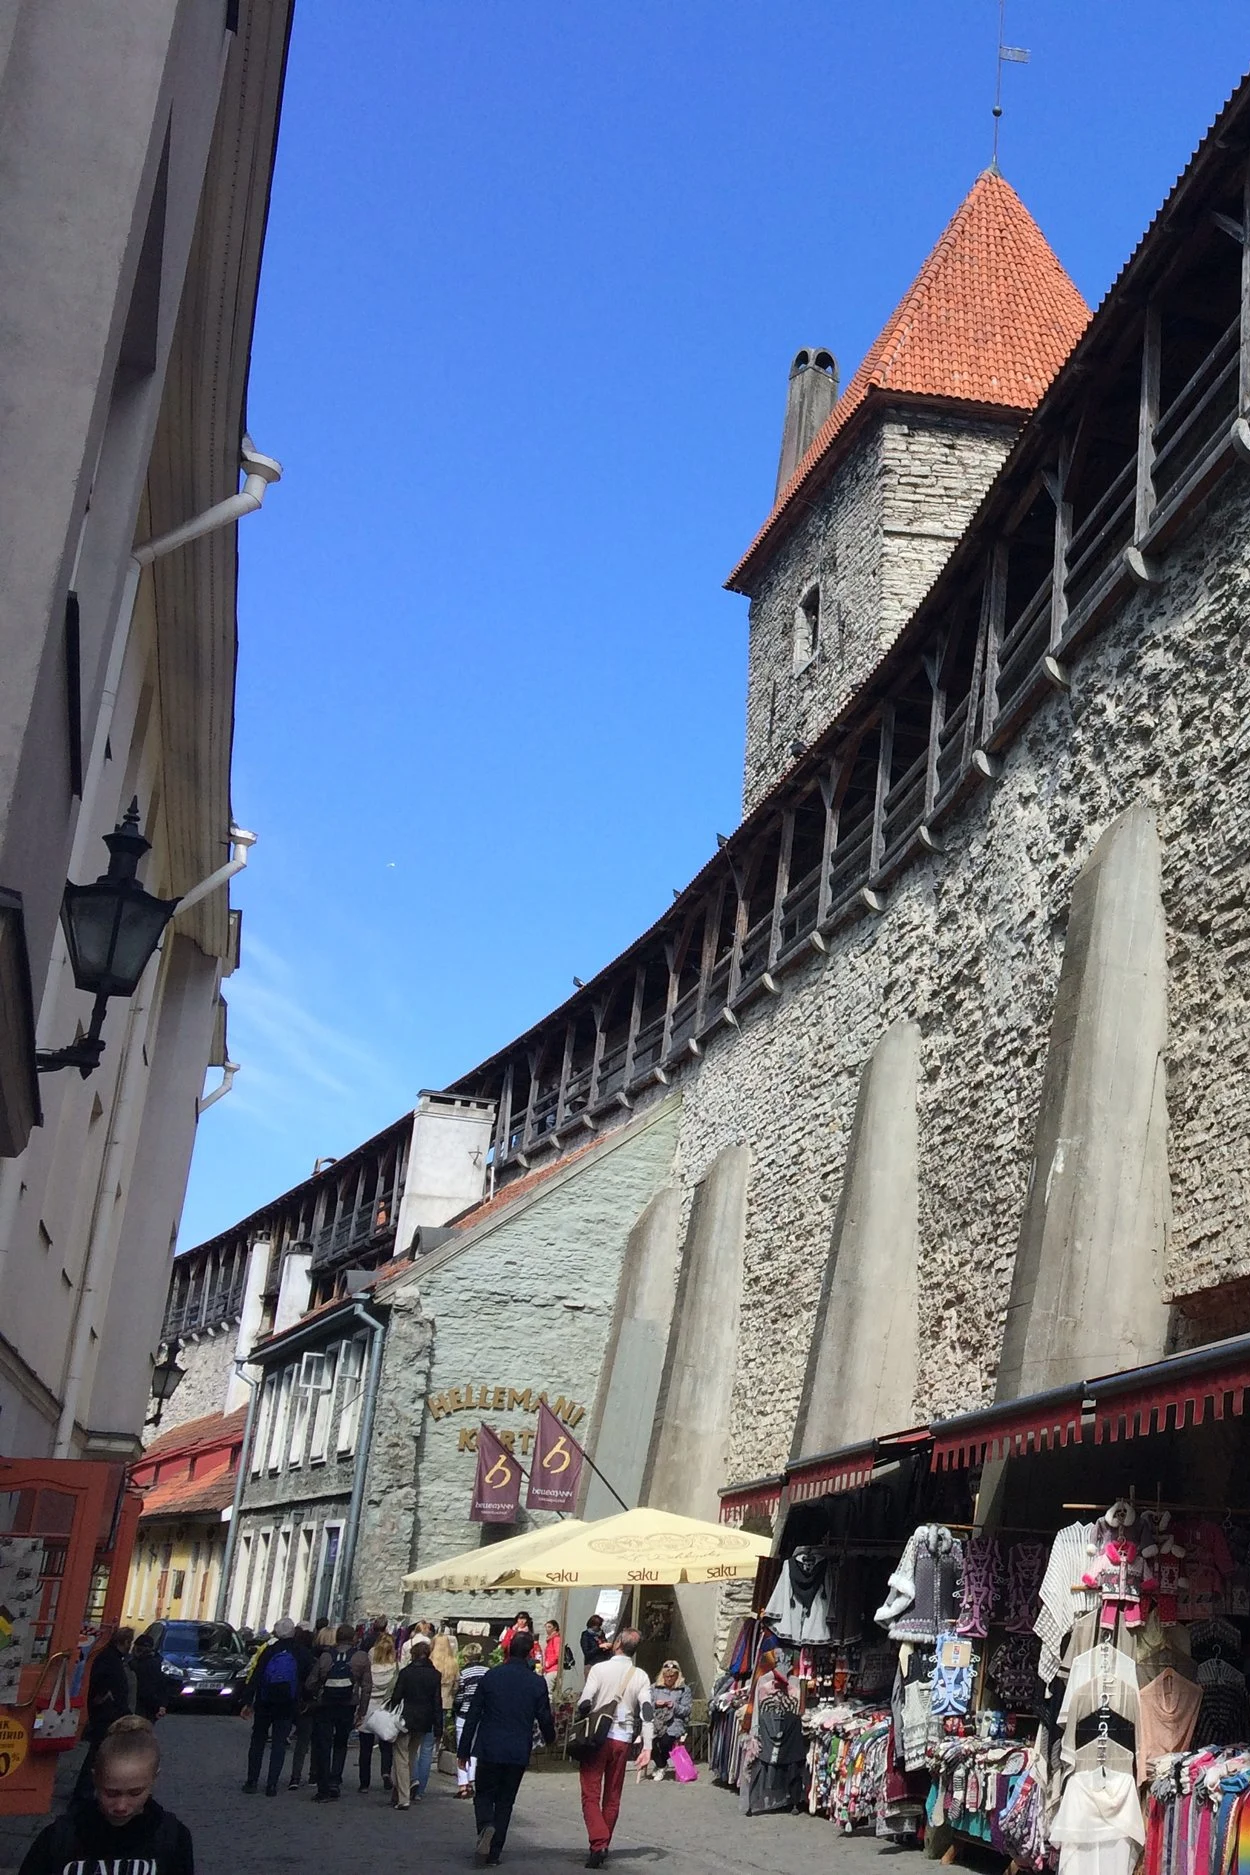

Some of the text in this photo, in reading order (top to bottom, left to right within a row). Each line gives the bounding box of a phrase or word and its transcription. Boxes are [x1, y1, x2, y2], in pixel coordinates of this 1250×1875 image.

[545, 1569, 579, 1582] saku
[627, 1568, 659, 1582] saku
[706, 1564, 737, 1579] saku
